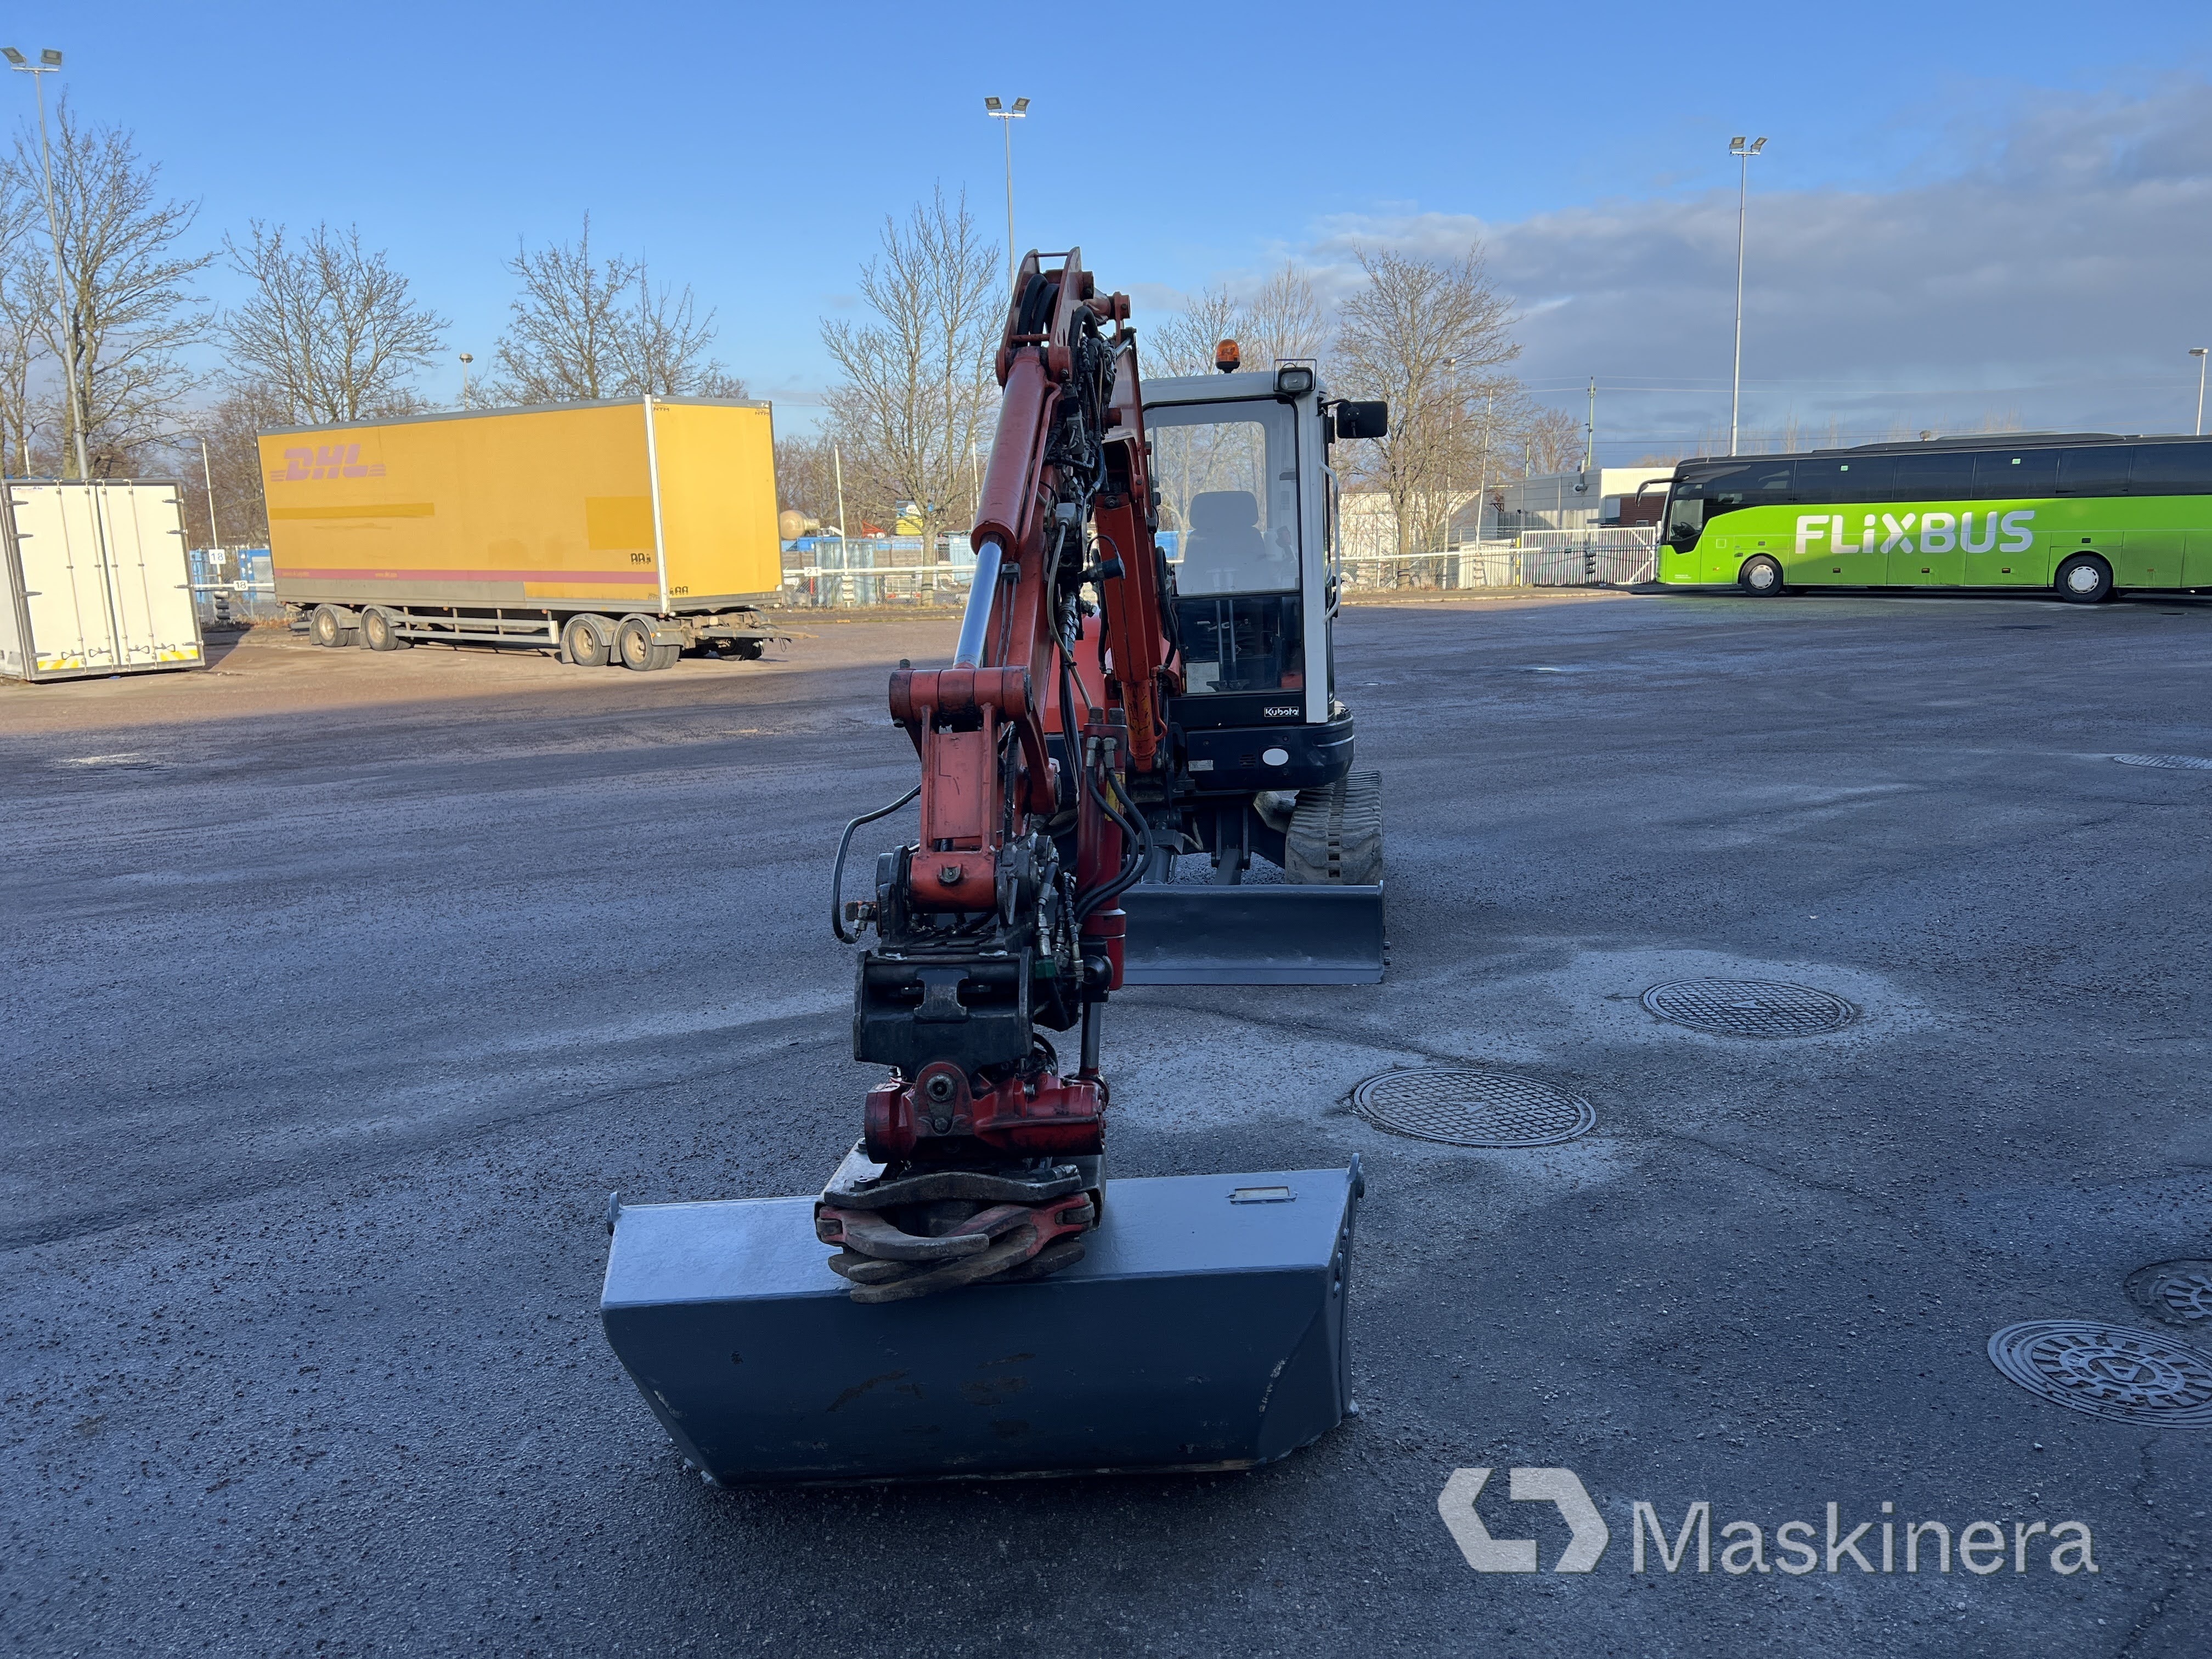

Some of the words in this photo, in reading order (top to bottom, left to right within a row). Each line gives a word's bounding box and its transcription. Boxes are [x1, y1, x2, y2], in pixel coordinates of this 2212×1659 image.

[284, 444, 369, 481] DHL
[211, 552, 224, 561] 18
[1265, 708, 1299, 716] Kubota
